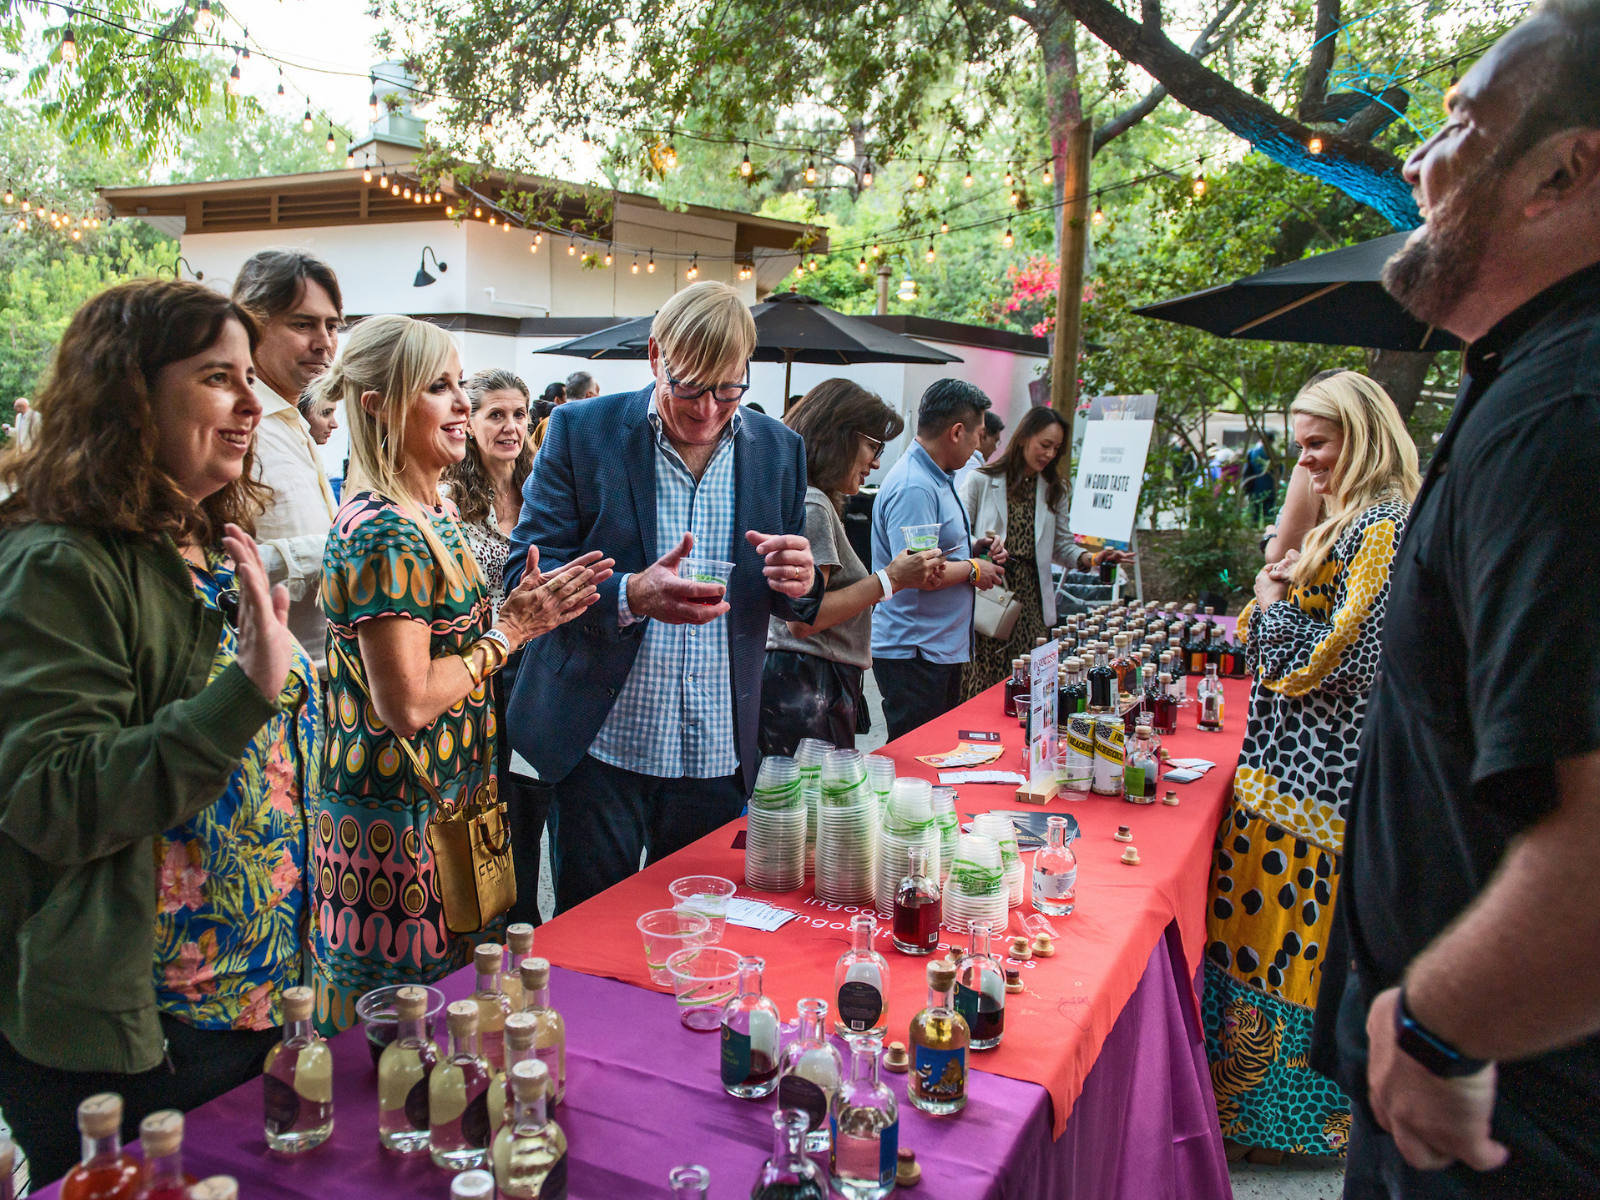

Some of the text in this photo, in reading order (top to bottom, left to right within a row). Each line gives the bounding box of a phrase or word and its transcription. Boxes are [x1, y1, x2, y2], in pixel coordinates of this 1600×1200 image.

[1084, 473, 1130, 492] IN GOOD TASTE
[1092, 492, 1113, 510] WINES
[478, 851, 511, 886] FENDI
